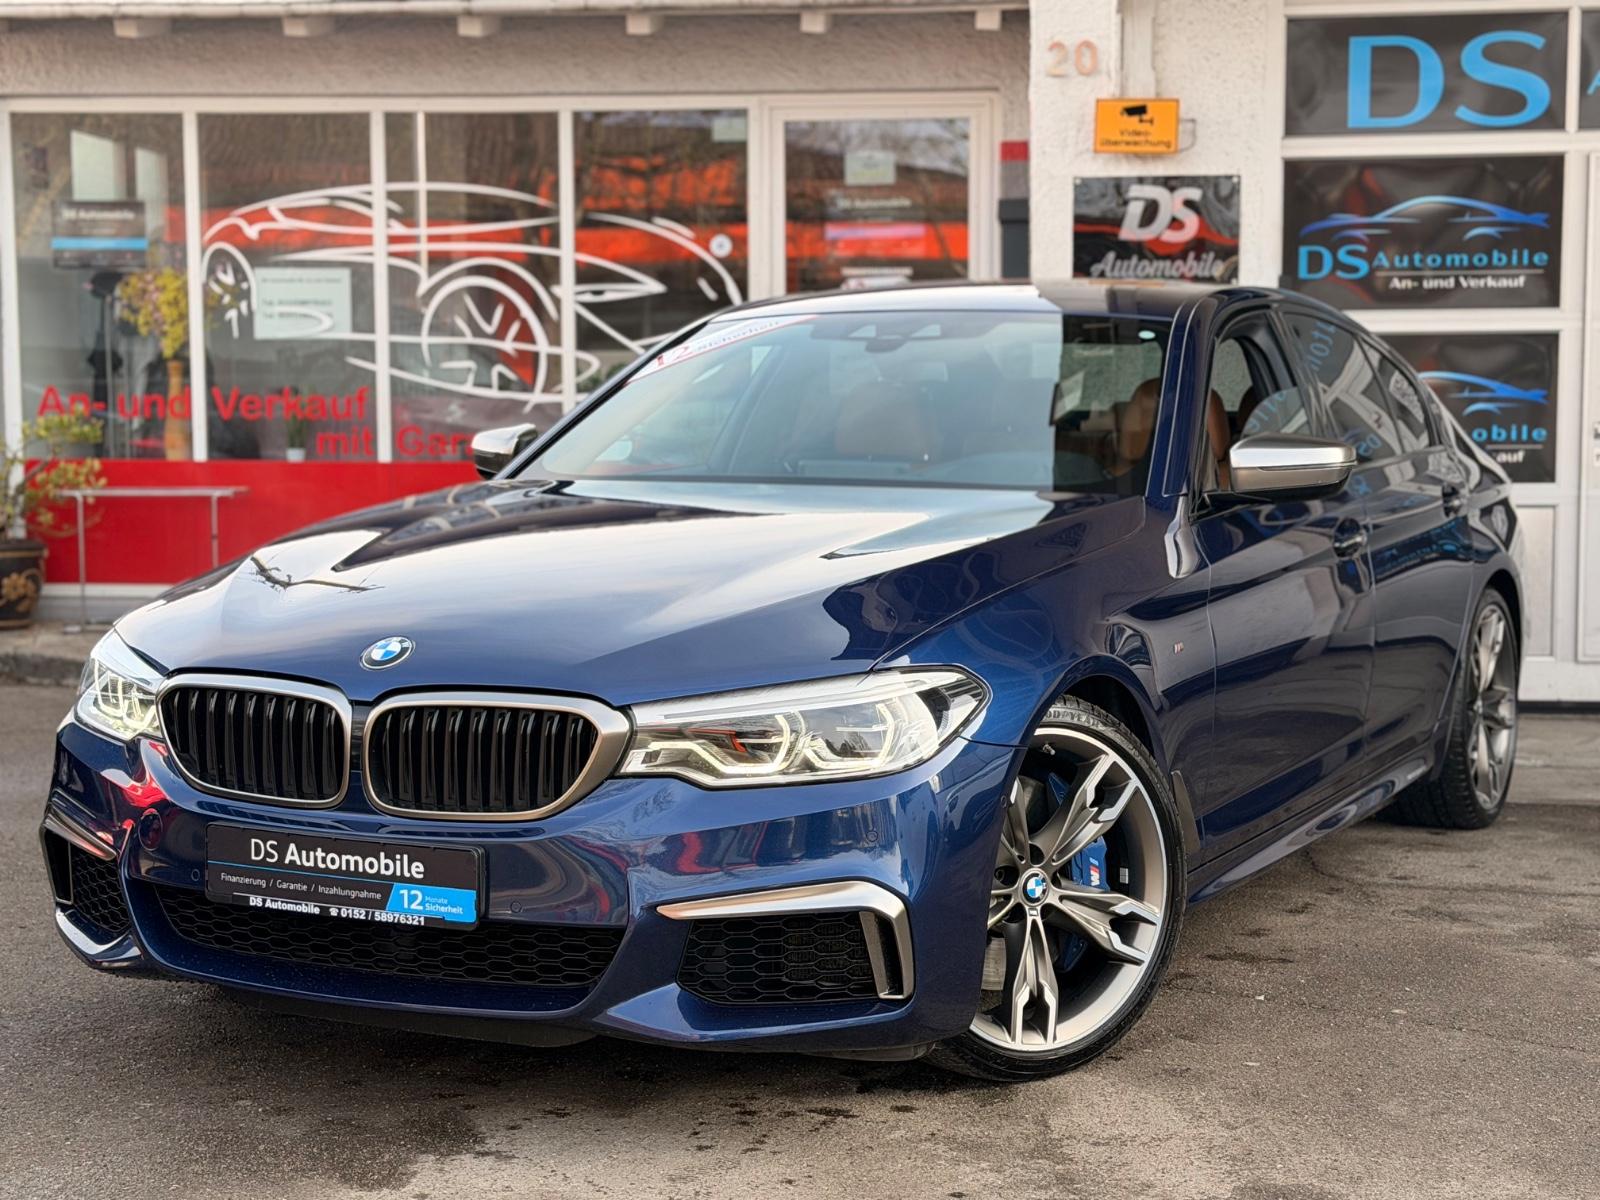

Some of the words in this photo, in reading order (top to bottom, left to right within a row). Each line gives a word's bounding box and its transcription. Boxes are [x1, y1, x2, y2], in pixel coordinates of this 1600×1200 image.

[1046, 40, 1098, 77] 20
[1347, 30, 1551, 128] DS
[1118, 184, 1203, 243] DS
[1089, 250, 1225, 279] Automobile
[1297, 244, 1370, 280] DS
[1372, 248, 1549, 269] Automobile
[1389, 276, 1419, 289] An-
[1423, 275, 1454, 289] und
[1459, 275, 1526, 288] Verkauf
[37, 384, 106, 417] An-
[117, 384, 192, 420] und
[211, 386, 369, 421] Verkauf
[316, 426, 373, 456] mit
[396, 425, 474, 456] Gar
[1472, 424, 1548, 442] obile
[251, 838, 278, 863] DS
[285, 842, 425, 879] Automobile
[220, 872, 267, 888] Finanzierung
[276, 879, 308, 891] Garantie
[318, 884, 382, 900] Inzahlungnahme
[400, 889, 423, 910] 12
[425, 895, 448, 904] Monate
[250, 896, 263, 907] DS
[265, 899, 321, 914] Automobile
[340, 908, 366, 920] 0152
[374, 911, 425, 926] 58976321
[425, 903, 464, 915] Sicherheit
